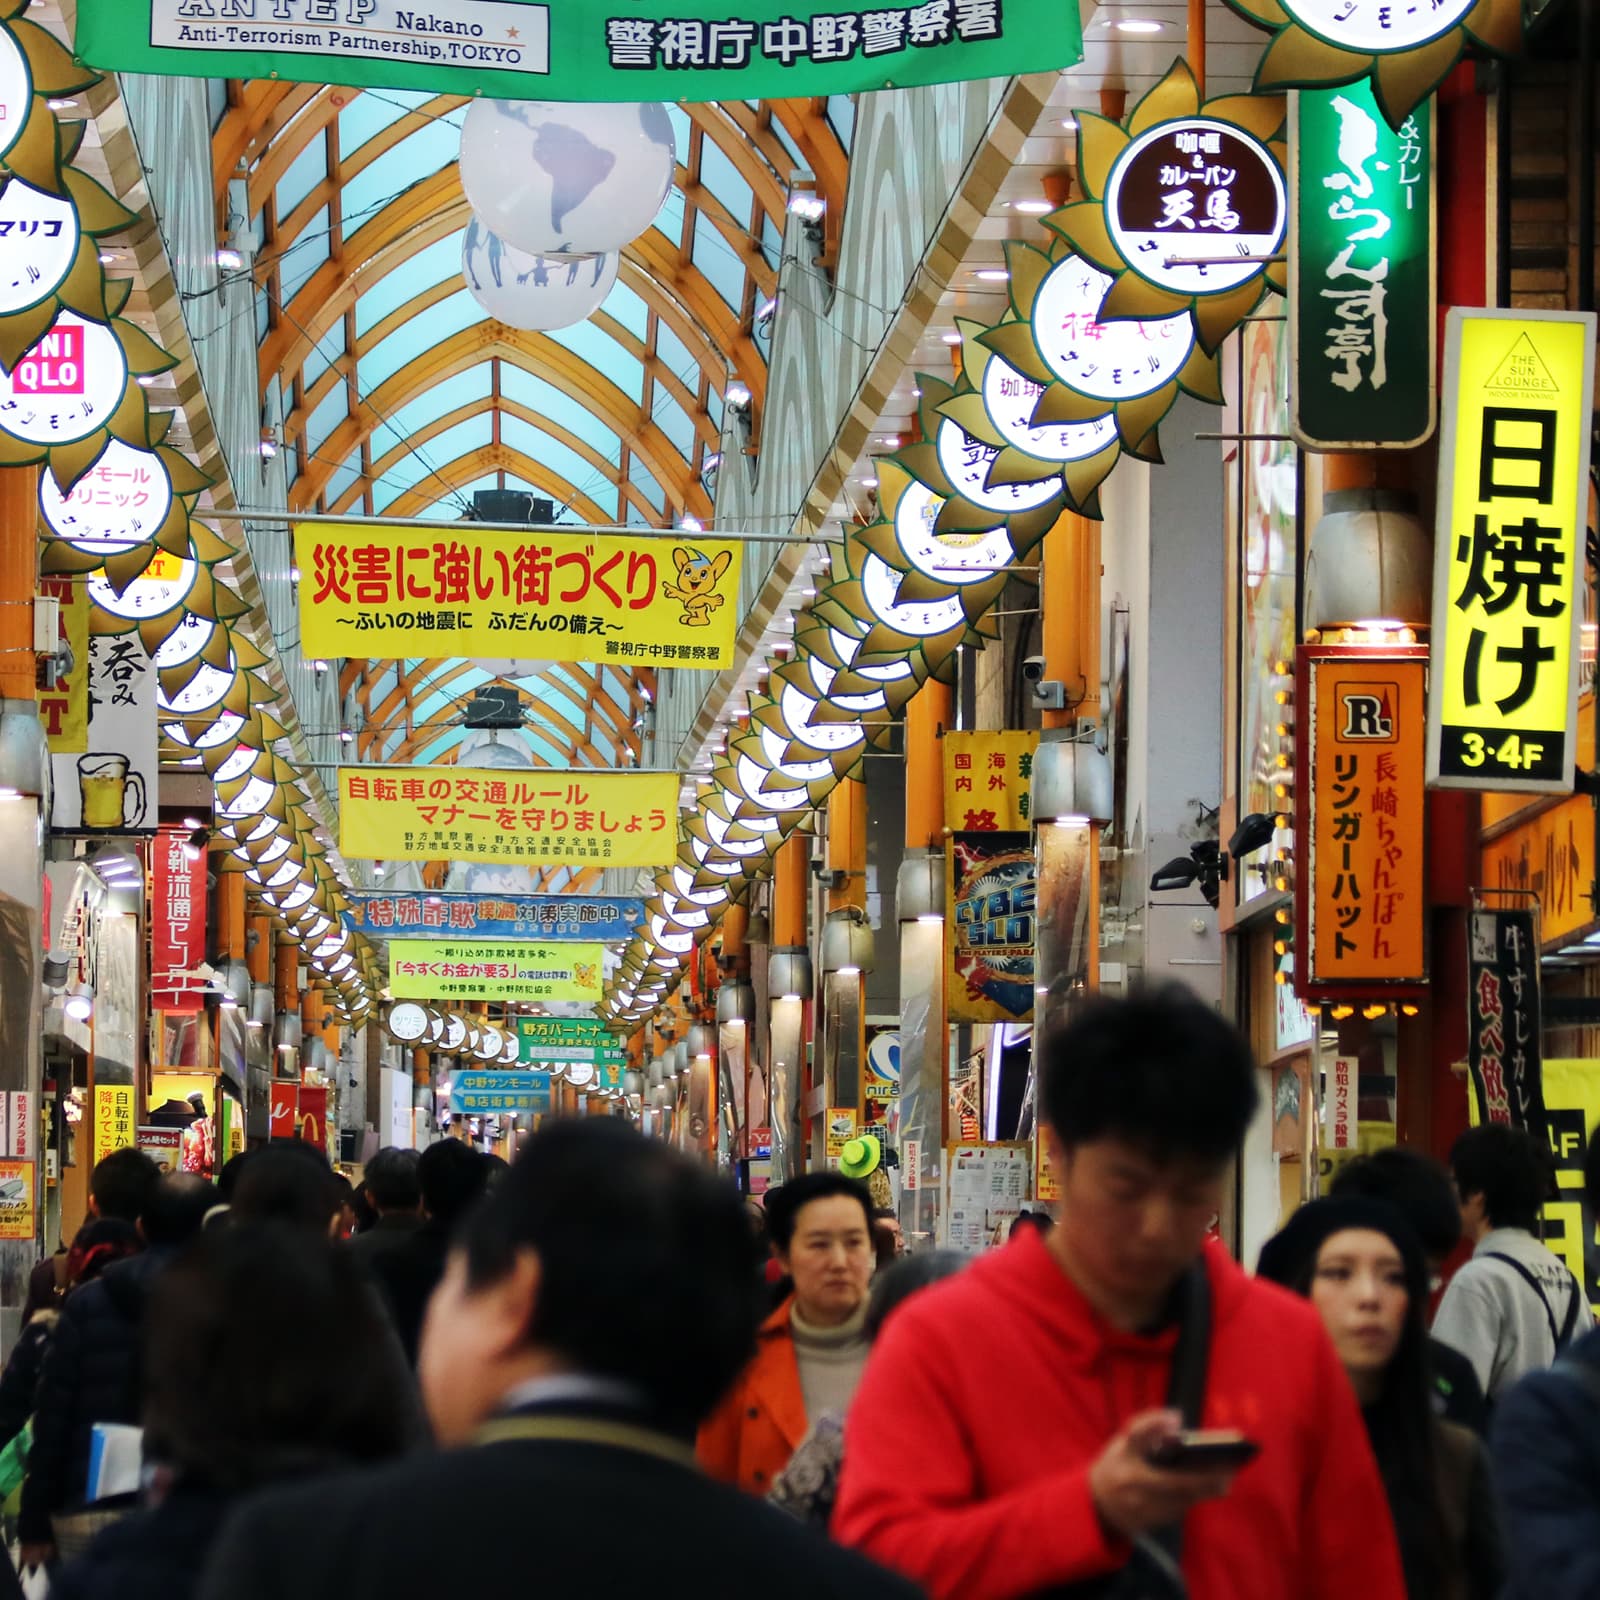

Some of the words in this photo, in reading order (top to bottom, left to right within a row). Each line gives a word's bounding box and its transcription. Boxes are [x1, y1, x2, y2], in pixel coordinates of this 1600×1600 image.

[178, 25, 322, 46] Anti-Terrorism
[396, 11, 483, 37] Nakano
[606, 0, 998, 65] 警視庁中野警察署
[1160, 165, 1236, 186] カレーパン
[1154, 188, 1240, 231] 天馬
[1510, 366, 1535, 376] SUN
[1511, 354, 1536, 365] THE
[19, 362, 77, 390] QLO
[1495, 376, 1549, 388] LOUNGE
[1455, 405, 1566, 717] 日焼け
[312, 541, 658, 611] 災害に強い街づくり
[605, 639, 720, 661] 警視庁中野警察署
[100, 640, 146, 706] 呑み
[347, 776, 590, 807] 自転車の交通ルール
[416, 803, 668, 834] マナーを守りましょう
[1331, 753, 1361, 960] リンガーハット
[1371, 751, 1403, 960] 長崎ちゃんぽん
[463, 1076, 543, 1089] 中野サンモール
